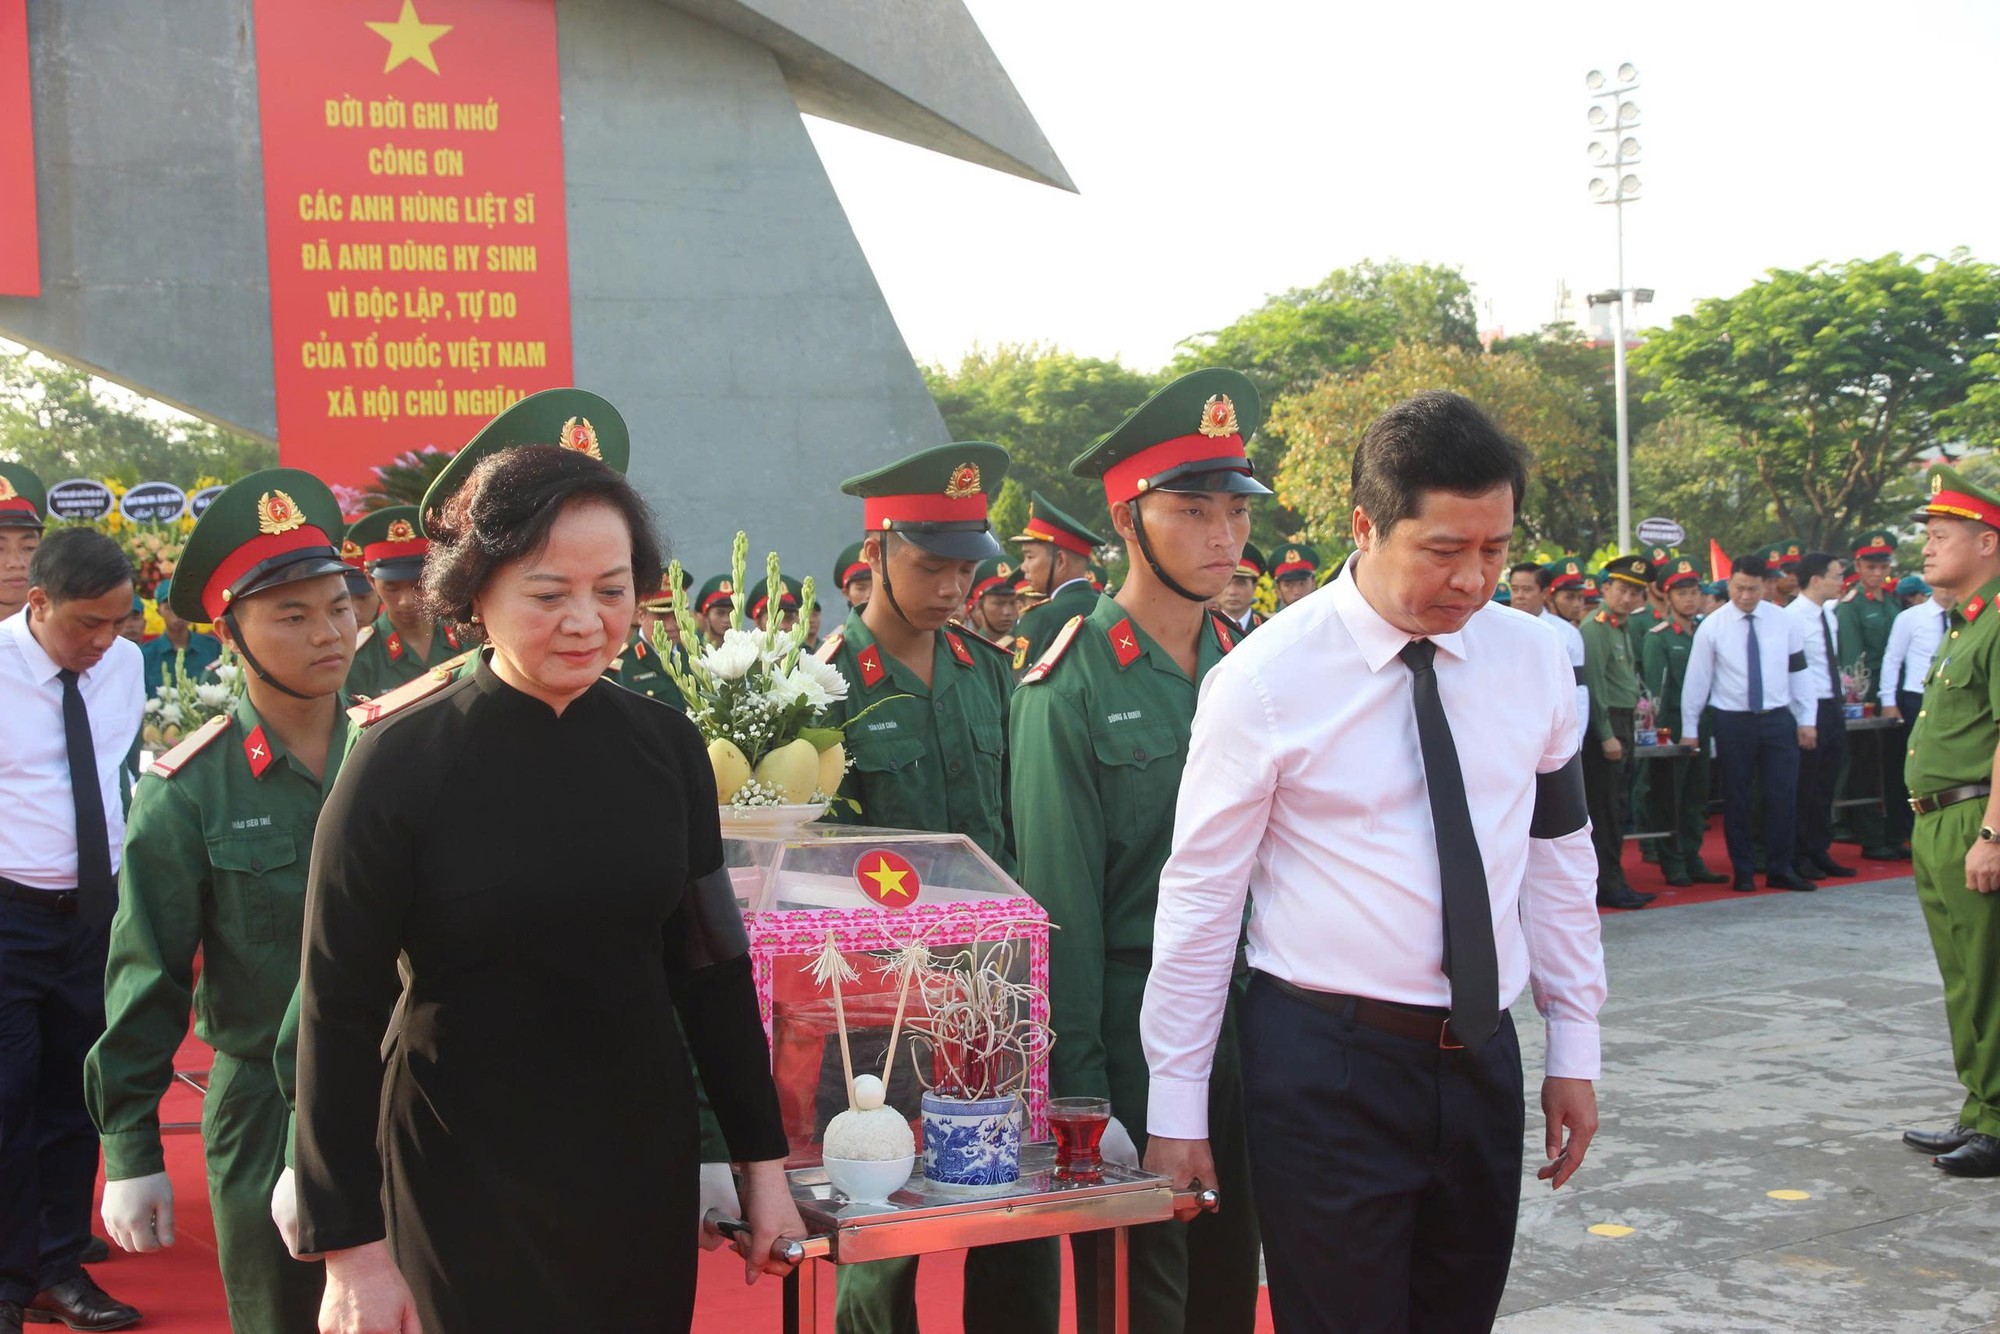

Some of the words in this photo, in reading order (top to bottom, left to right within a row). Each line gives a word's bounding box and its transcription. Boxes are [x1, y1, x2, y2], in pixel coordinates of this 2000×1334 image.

[325, 95, 364, 128] ĐỜI
[369, 95, 407, 128] ĐỜI
[412, 101, 448, 129] GHI
[454, 99, 499, 132] NHỚ
[368, 143, 428, 176] CÔNG
[433, 147, 464, 176] ƠN
[299, 189, 343, 222] CÁC
[349, 193, 395, 222] ANH
[400, 192, 459, 223] HÙNG
[464, 191, 508, 227] LIỆT
[513, 192, 535, 223] SĨ
[301, 237, 332, 271] ĐÃ
[337, 243, 384, 271] ANH
[389, 239, 448, 272] DŨNG
[453, 244, 480, 272] HY
[486, 244, 537, 272] SINH
[327, 286, 350, 318] VÌ
[355, 286, 399, 323] ĐỘC
[404, 286, 452, 323] LẬP,
[456, 289, 485, 322] TỰ
[489, 290, 517, 319] DO
[302, 330, 347, 369] CỦA
[351, 331, 379, 368] TỔ
[384, 333, 442, 370] QUỐC
[446, 336, 492, 372] VIỆT
[497, 340, 547, 368] NAM
[327, 385, 357, 417] XÃ
[361, 383, 400, 422] HỘI
[404, 379, 448, 417] CHỦ
